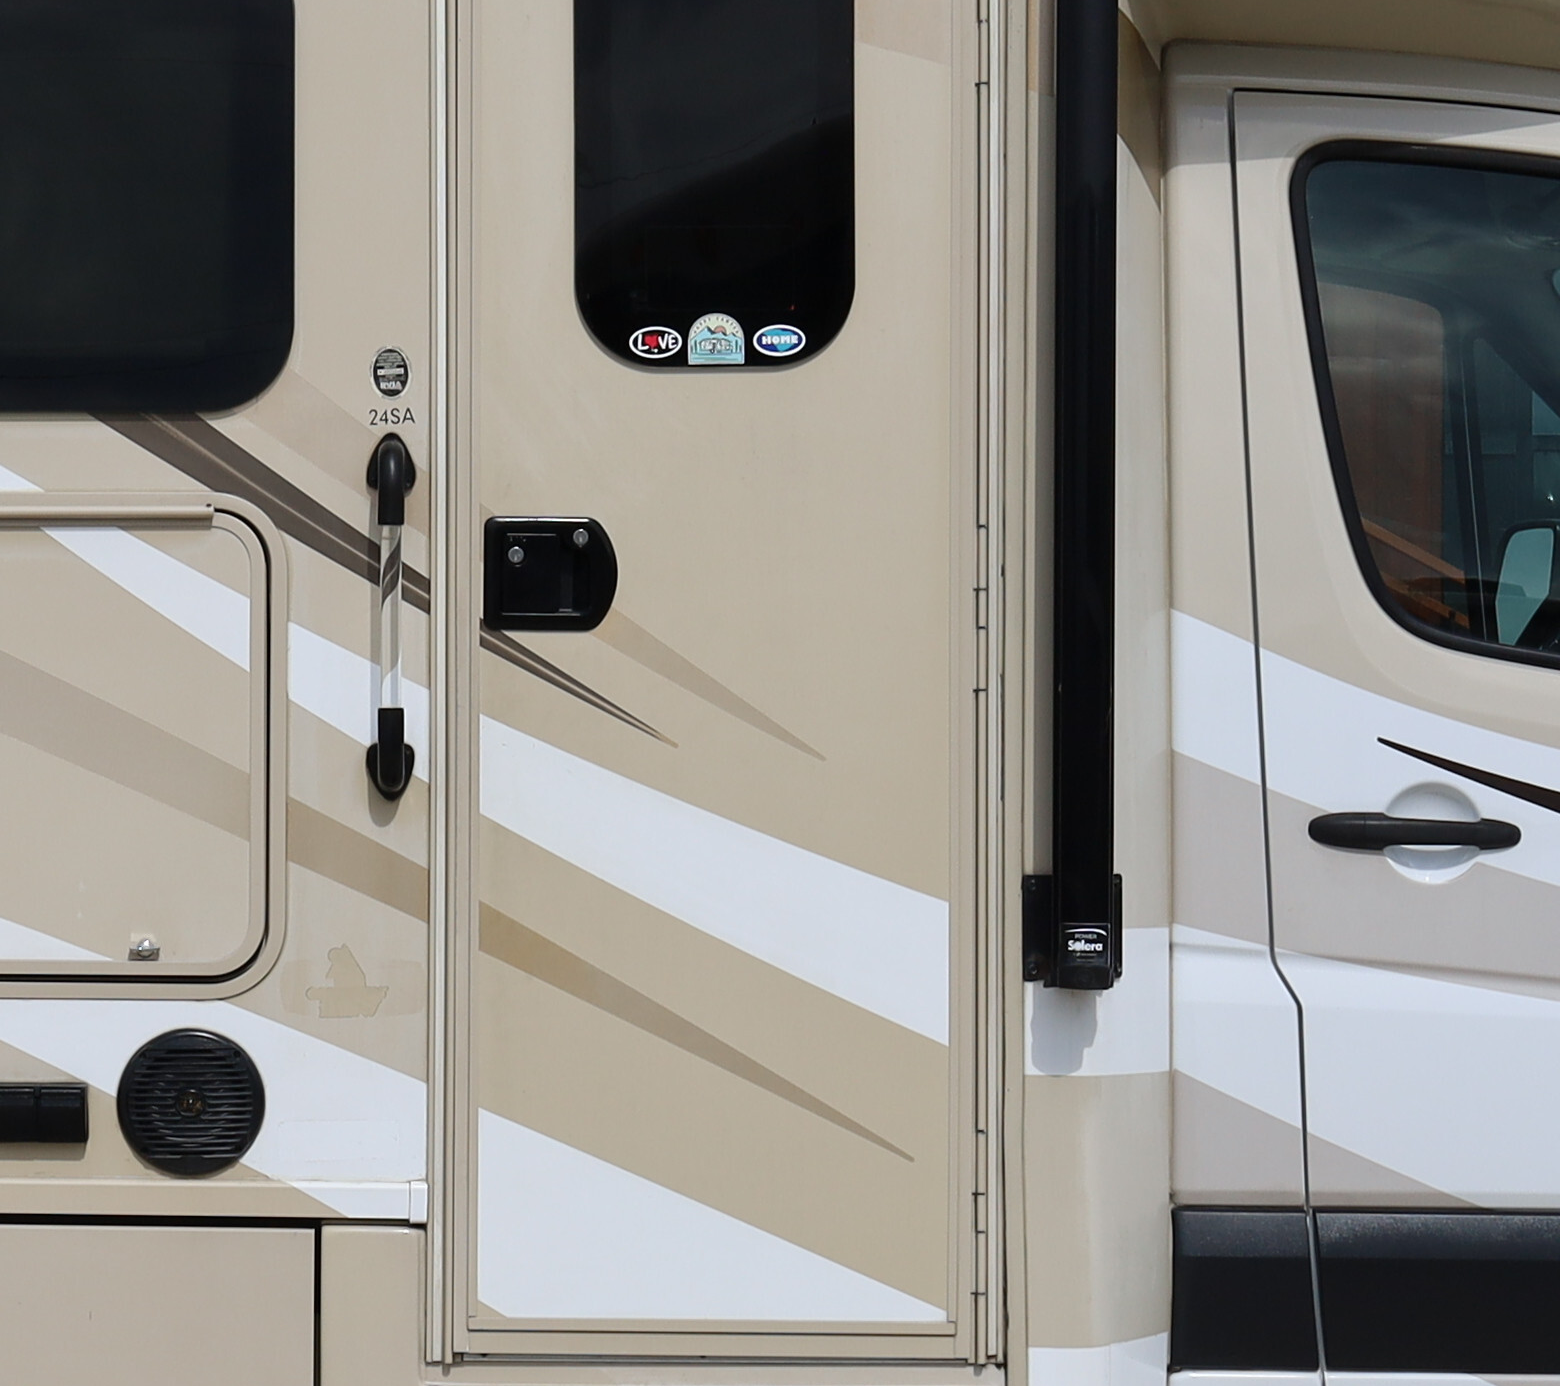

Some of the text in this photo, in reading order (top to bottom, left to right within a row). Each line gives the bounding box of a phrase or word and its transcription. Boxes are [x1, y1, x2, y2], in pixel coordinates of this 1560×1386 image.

[761, 334, 799, 345] HOME
[368, 408, 416, 426] 24SA
[1067, 940, 1104, 952] Solera
